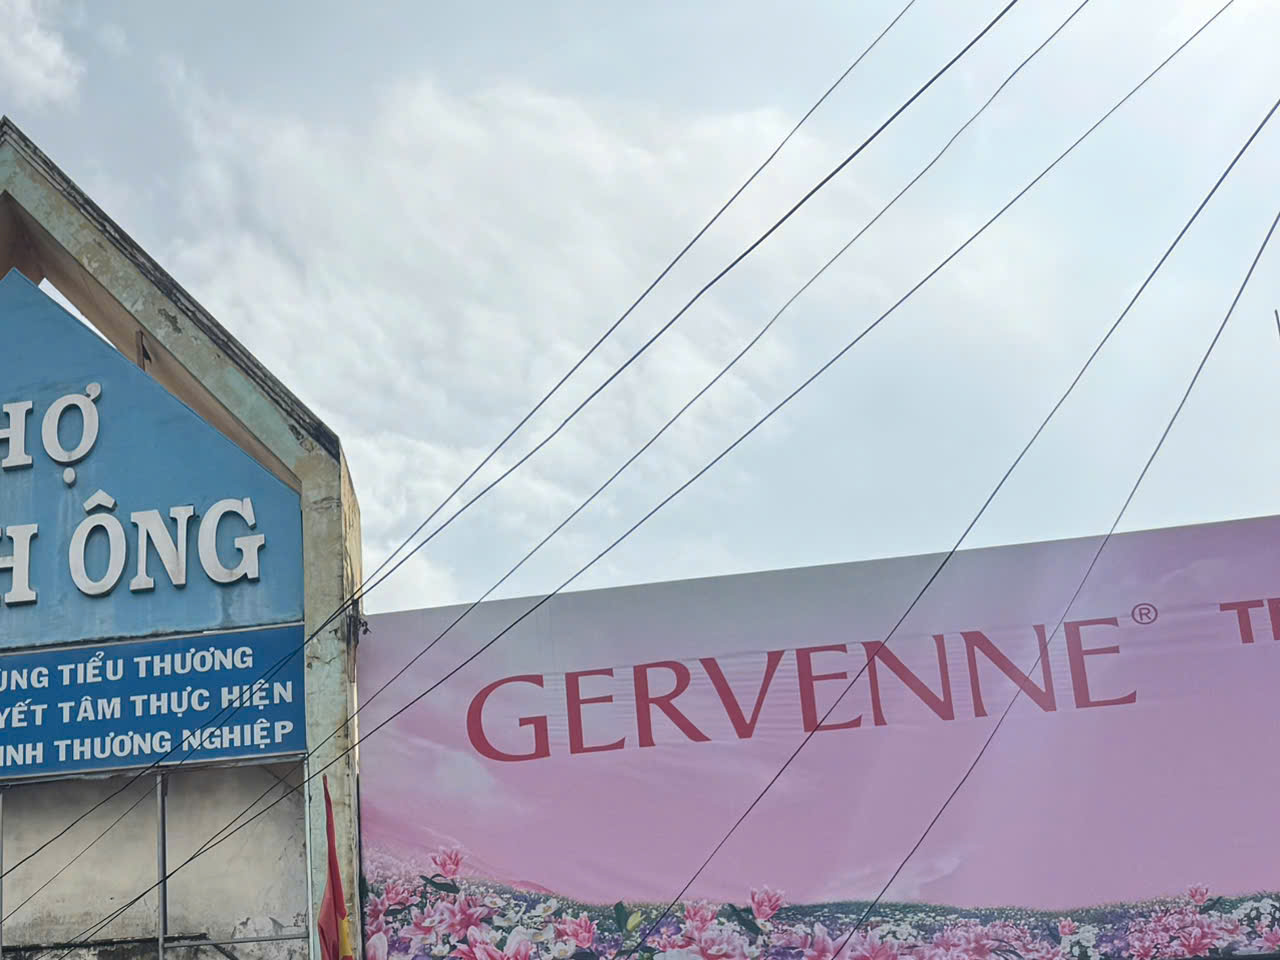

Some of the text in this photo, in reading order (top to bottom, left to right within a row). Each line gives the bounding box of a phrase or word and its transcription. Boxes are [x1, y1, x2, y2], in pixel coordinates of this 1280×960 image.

[69, 489, 265, 596] ÔNG
[58, 651, 124, 685] TIỂU
[134, 646, 253, 677] THƯƠNG
[58, 696, 120, 723] TÂM
[130, 686, 210, 717] THỰC
[221, 679, 293, 710] HIỆN
[54, 731, 171, 761] THƯƠNG
[182, 718, 294, 751] NGHIỆP
